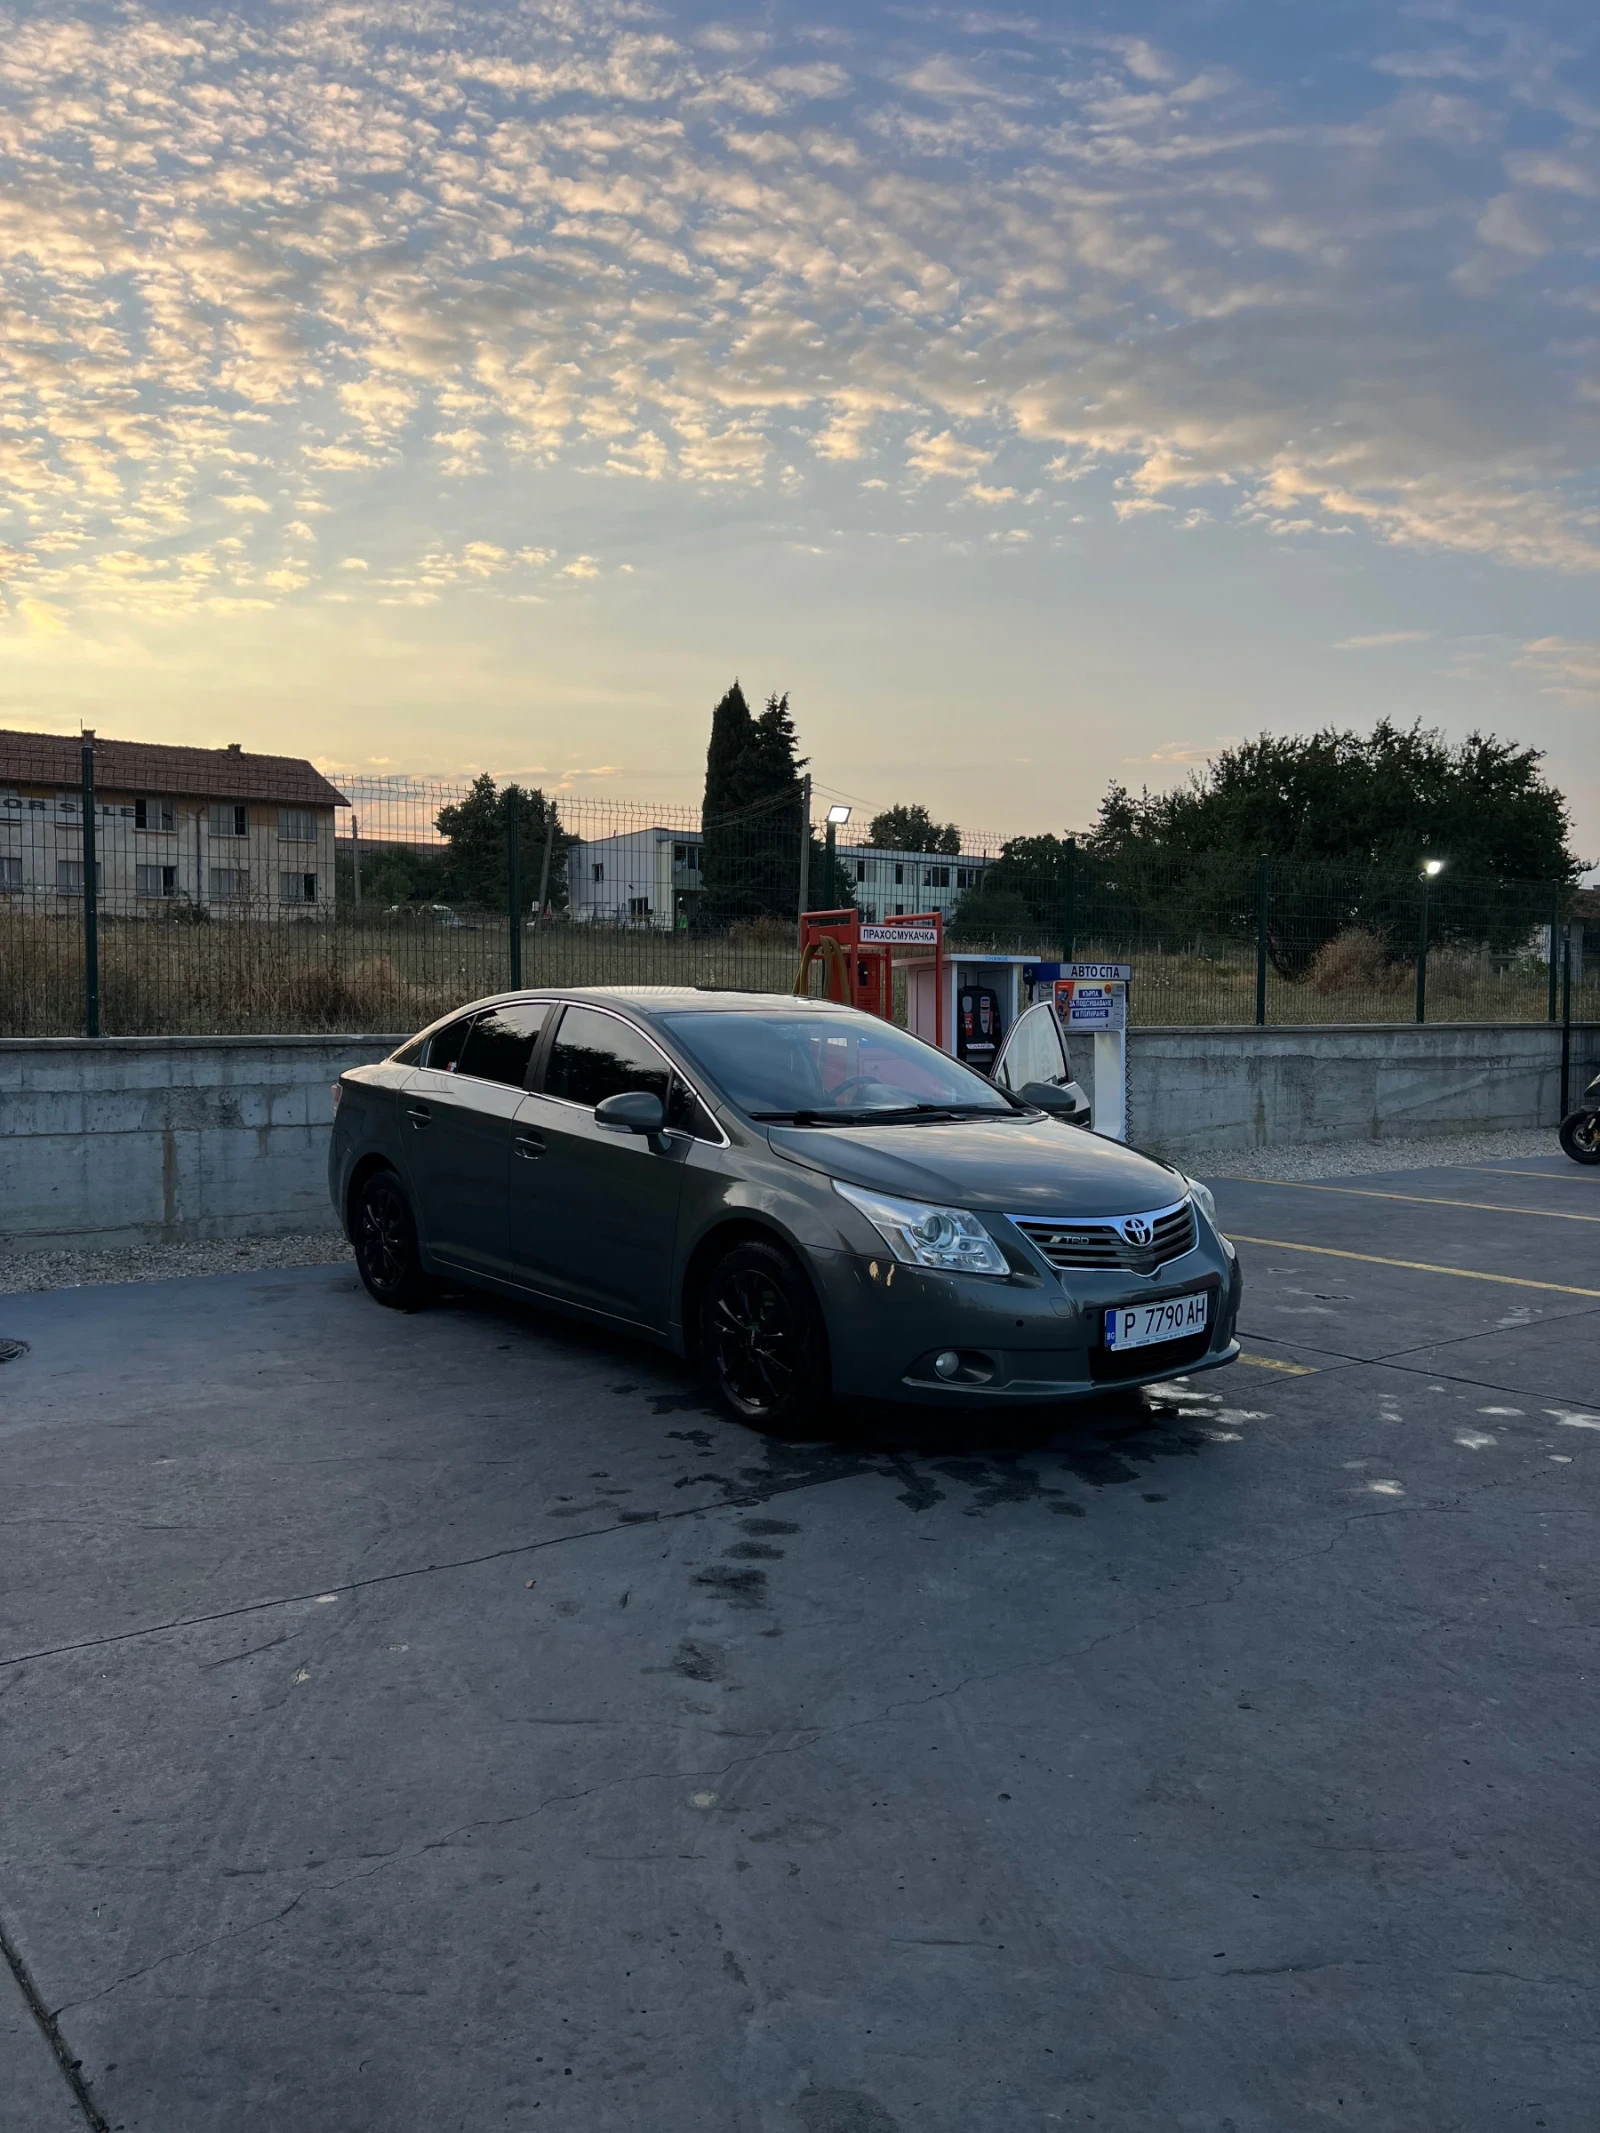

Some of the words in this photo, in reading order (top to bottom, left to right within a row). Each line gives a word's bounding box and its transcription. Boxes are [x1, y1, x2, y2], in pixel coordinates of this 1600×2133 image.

[59, 802, 135, 818] SLE
[863, 929, 936, 941] ПРАХОСМУКАЧКА
[1071, 965, 1098, 978] АВТО
[1099, 966, 1120, 978] СПА
[1063, 1235, 1090, 1245] TRD
[1124, 1312, 1136, 1338] P
[1145, 1303, 1184, 1335] 7790
[1186, 1297, 1206, 1326] AH
[1106, 1331, 1115, 1341] BG
